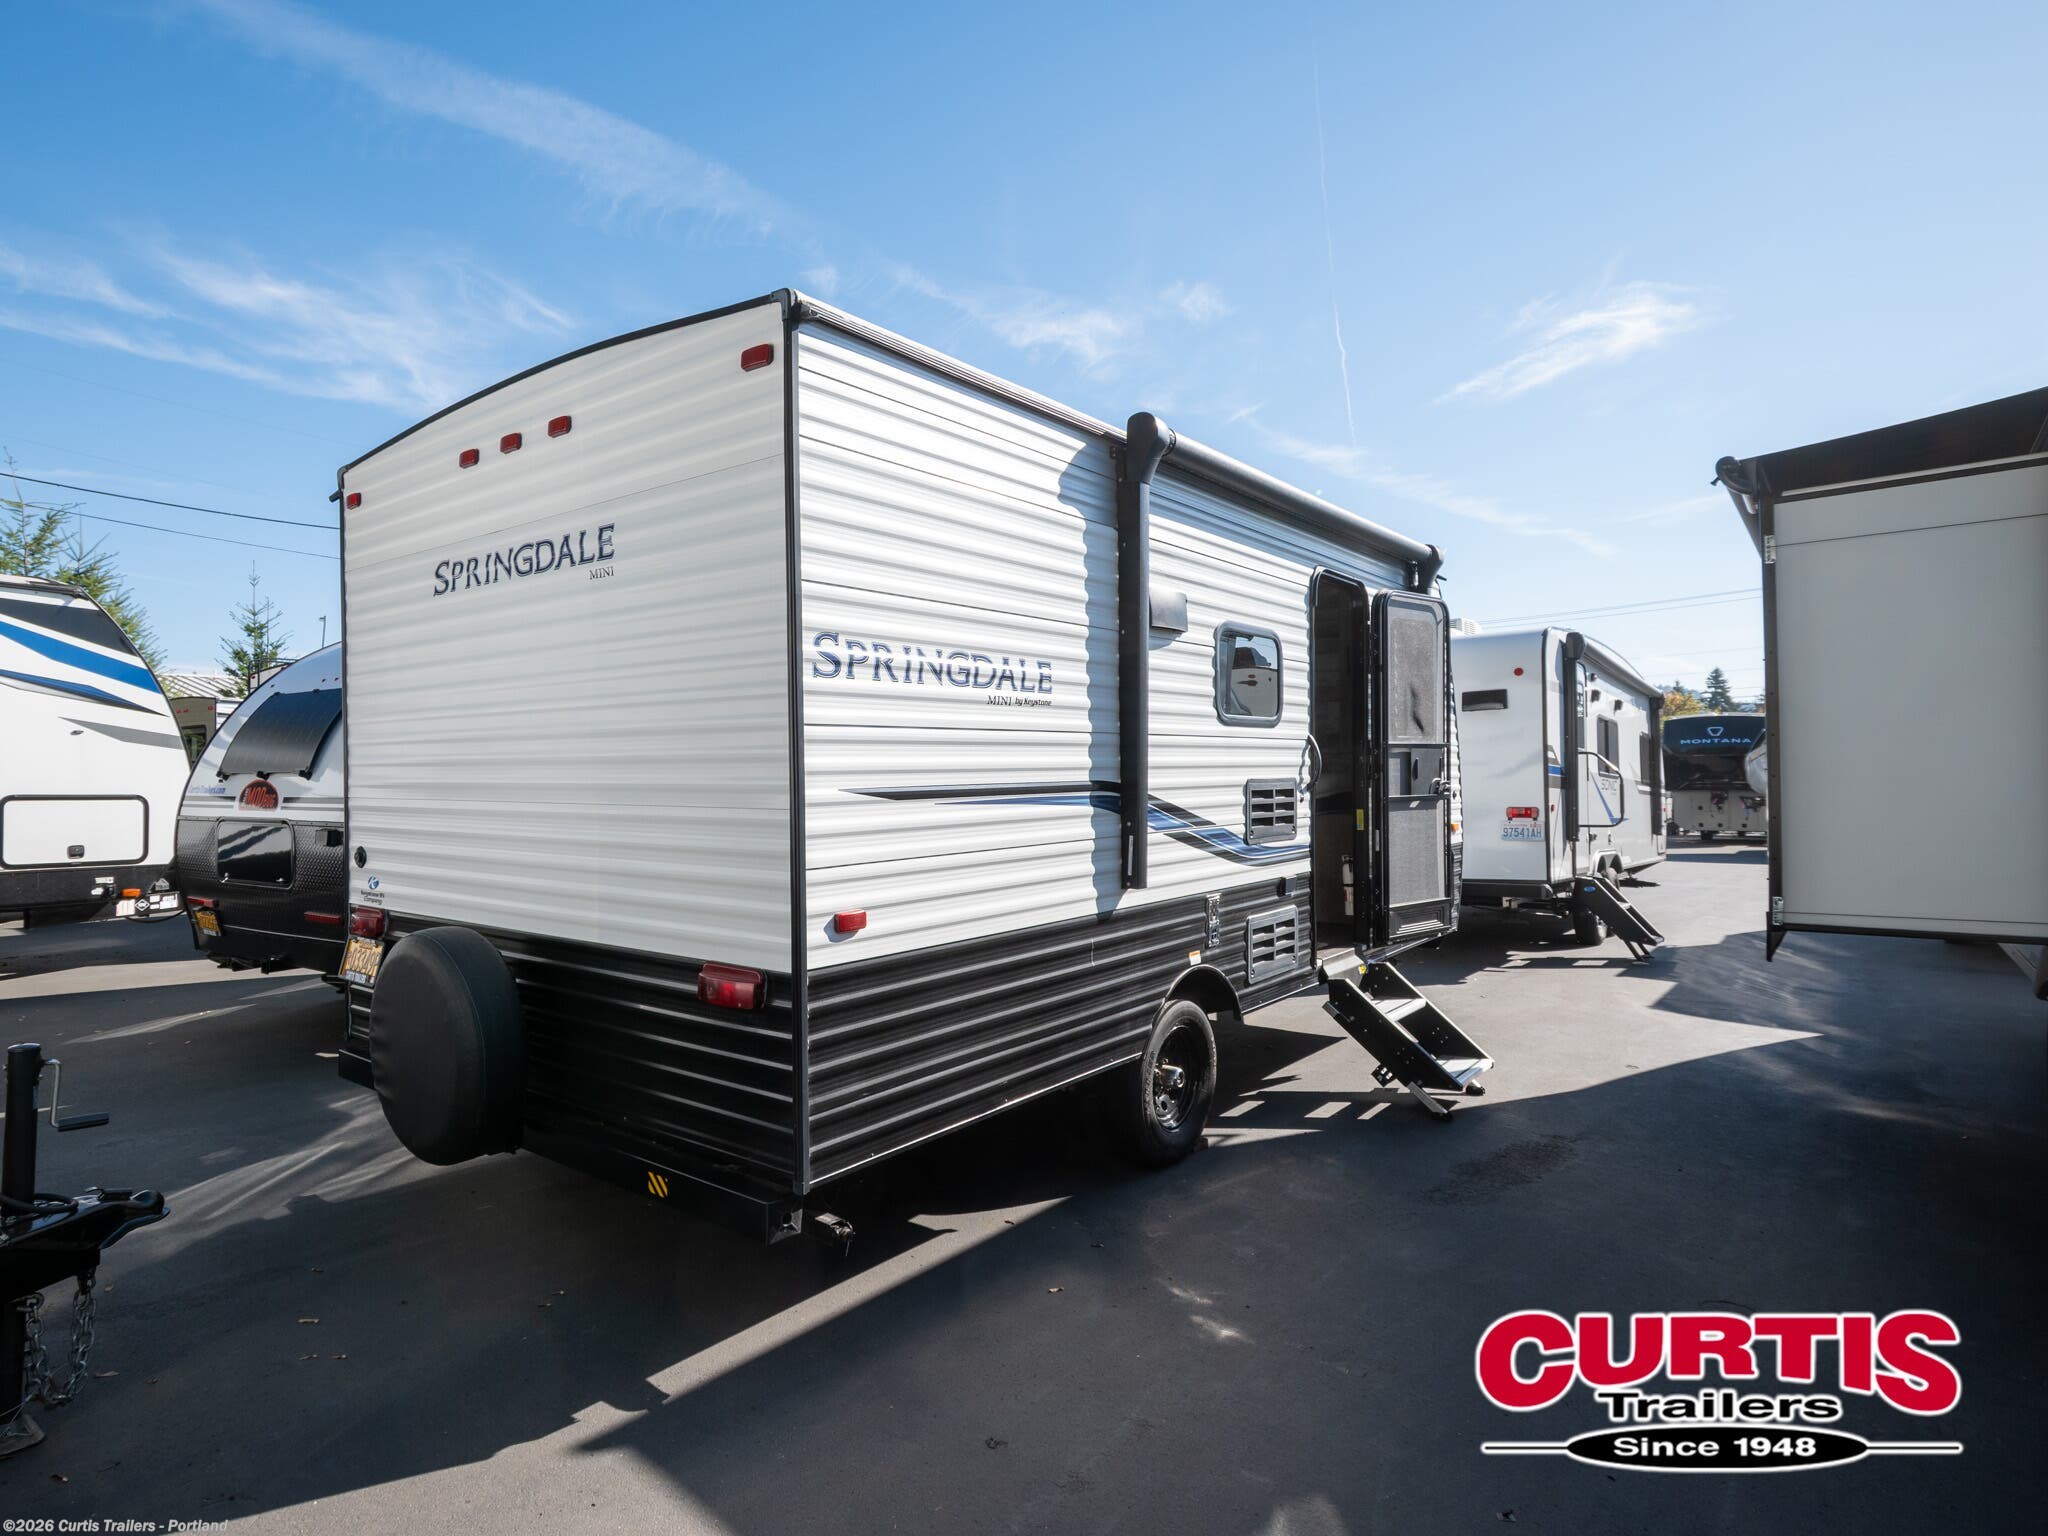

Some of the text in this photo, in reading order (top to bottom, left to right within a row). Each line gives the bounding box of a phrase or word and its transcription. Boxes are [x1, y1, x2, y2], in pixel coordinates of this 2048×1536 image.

[433, 523, 615, 597] SPRINGDALE
[589, 566, 615, 580] MINI
[812, 631, 1053, 694] SPRINGDALE
[986, 695, 1012, 706] MINI
